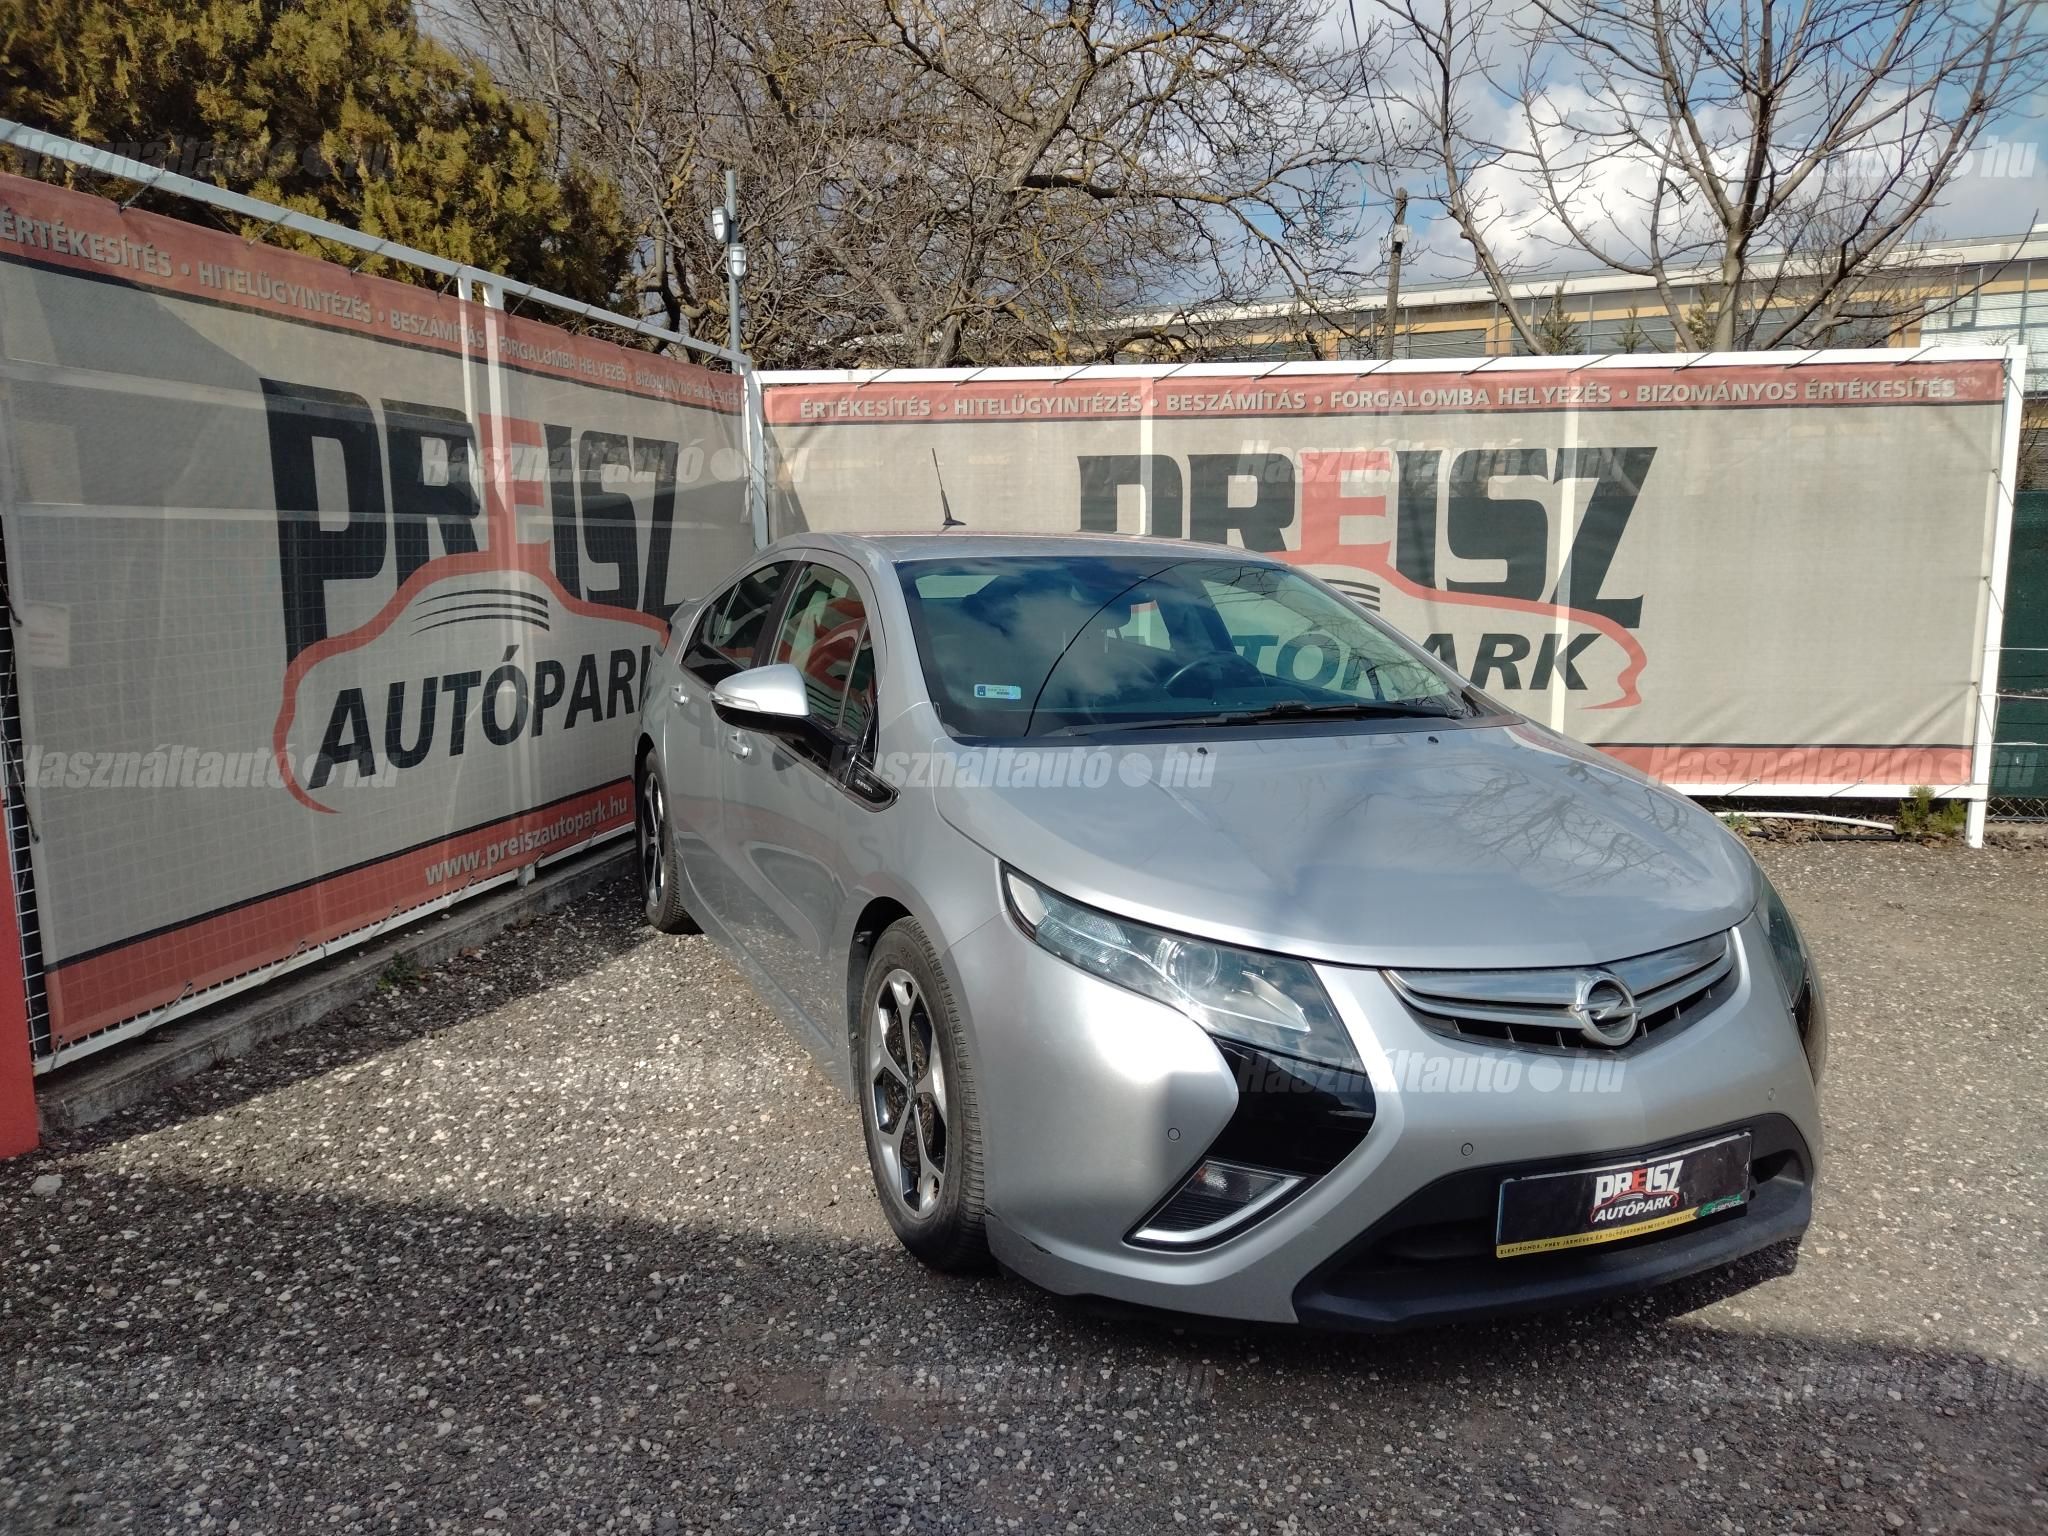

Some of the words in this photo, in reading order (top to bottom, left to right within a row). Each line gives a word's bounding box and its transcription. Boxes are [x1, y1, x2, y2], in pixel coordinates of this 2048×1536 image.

[0, 207, 173, 277] ÉRTÉKESÍTÉS
[199, 261, 372, 324] HITELÜGYINTÉZÉS
[390, 309, 485, 350] BESZÁMÍTÁS
[800, 395, 932, 418] ÉRTÉKESÍTÉS
[954, 392, 1142, 416] HITELÜGYINTÉZÉS
[1166, 389, 1307, 412] BESZÁMÍTÁS
[1330, 389, 1491, 410] FORGALOMBA
[1498, 382, 1611, 406] HELYEZÉS
[1636, 377, 1798, 403] BIZOMÁNYOS
[1805, 376, 1956, 400] ÉRTÉKESÍTÉS
[259, 378, 684, 668] PREISZ
[425, 796, 627, 886] www.preiszautopark.hu
[1594, 1160, 1684, 1207] PREISZ
[1594, 1195, 1673, 1223] AUTÓPARK
